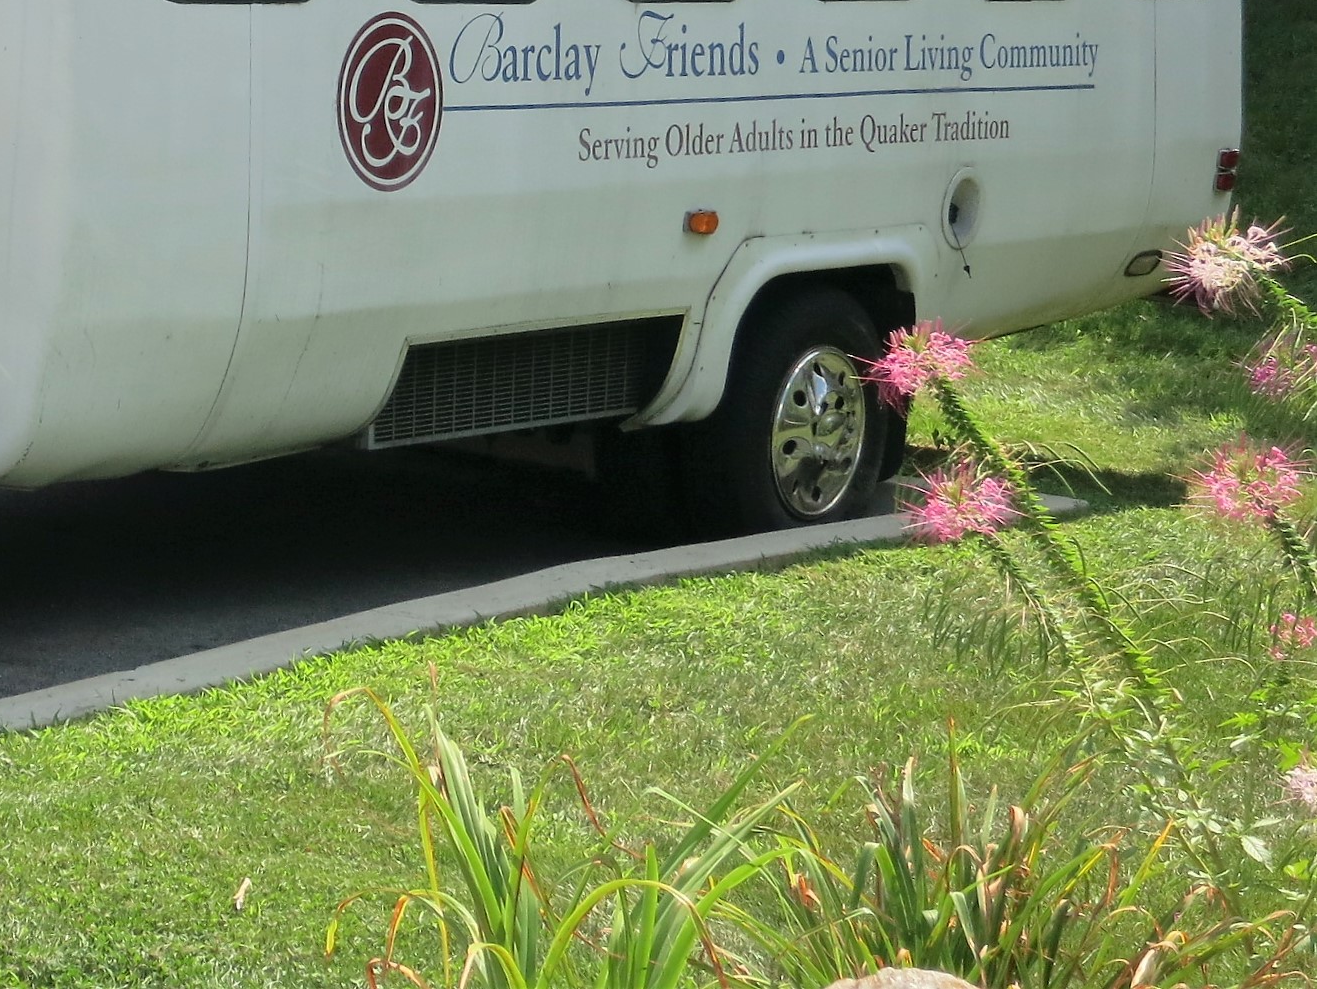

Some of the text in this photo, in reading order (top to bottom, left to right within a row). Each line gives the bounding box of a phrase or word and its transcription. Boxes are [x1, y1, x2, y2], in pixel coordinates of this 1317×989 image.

[449, 10, 1099, 96] Barclay Friends A Senior Living Community
[578, 110, 1010, 169] Serving Older Adults in the Quaker Tradition
